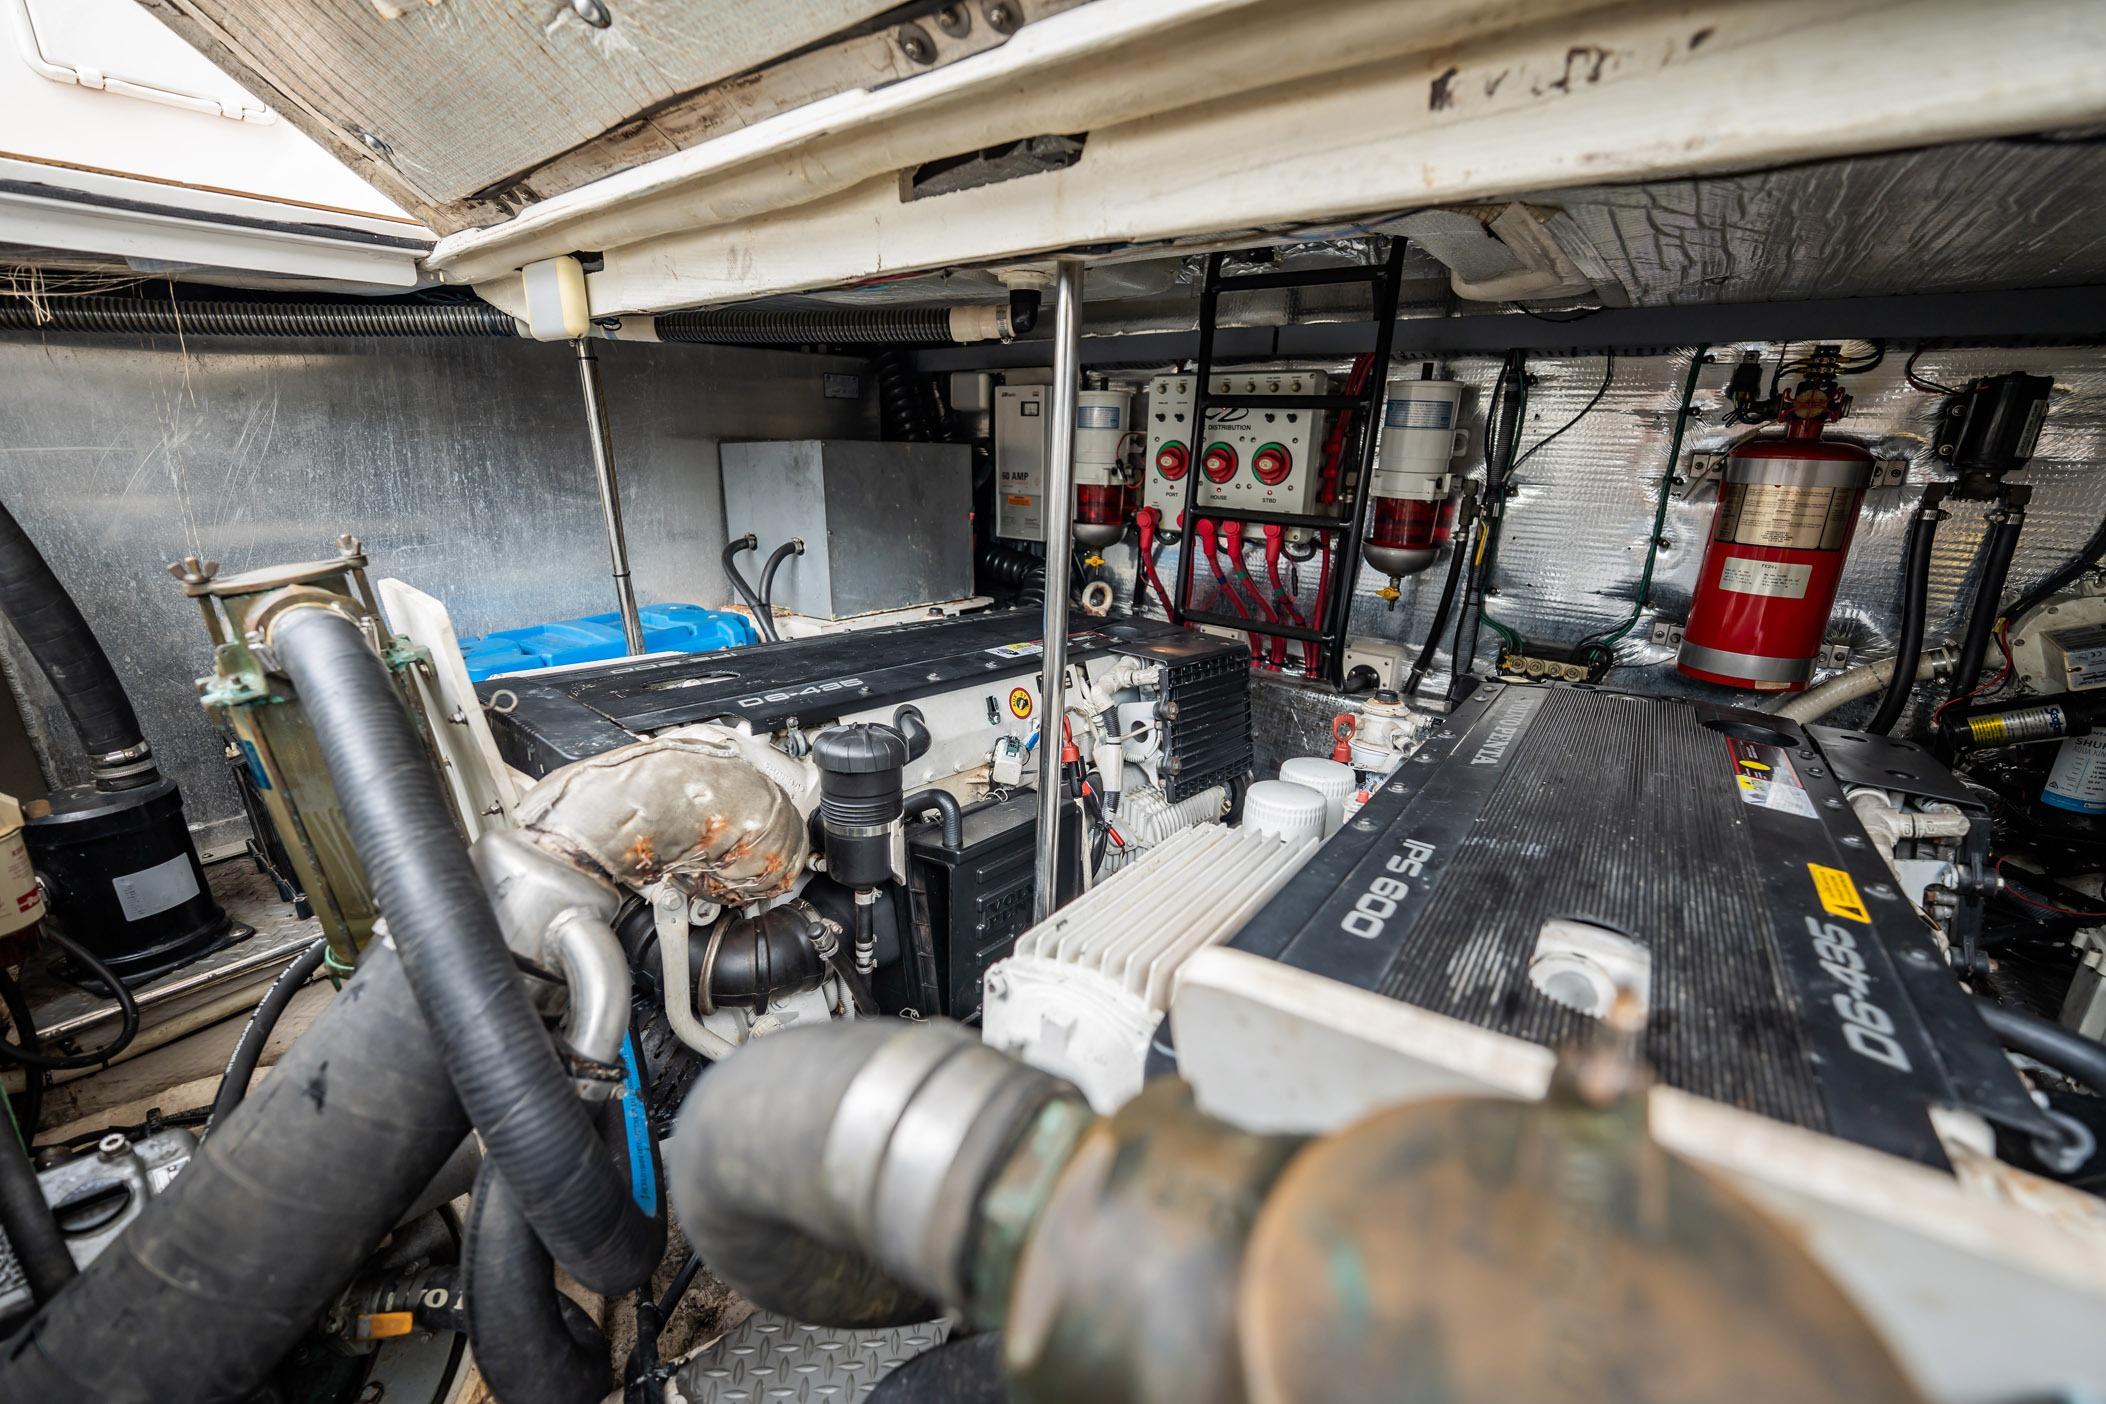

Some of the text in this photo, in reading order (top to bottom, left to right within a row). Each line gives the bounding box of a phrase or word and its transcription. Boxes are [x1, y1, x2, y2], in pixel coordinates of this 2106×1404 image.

[1011, 472, 1029, 481] AMP
[737, 677, 864, 708] D6-435
[1470, 726, 1518, 765] PENTA
[1340, 838, 1437, 939] IPS 600
[1804, 915, 1913, 1073] D6-435
